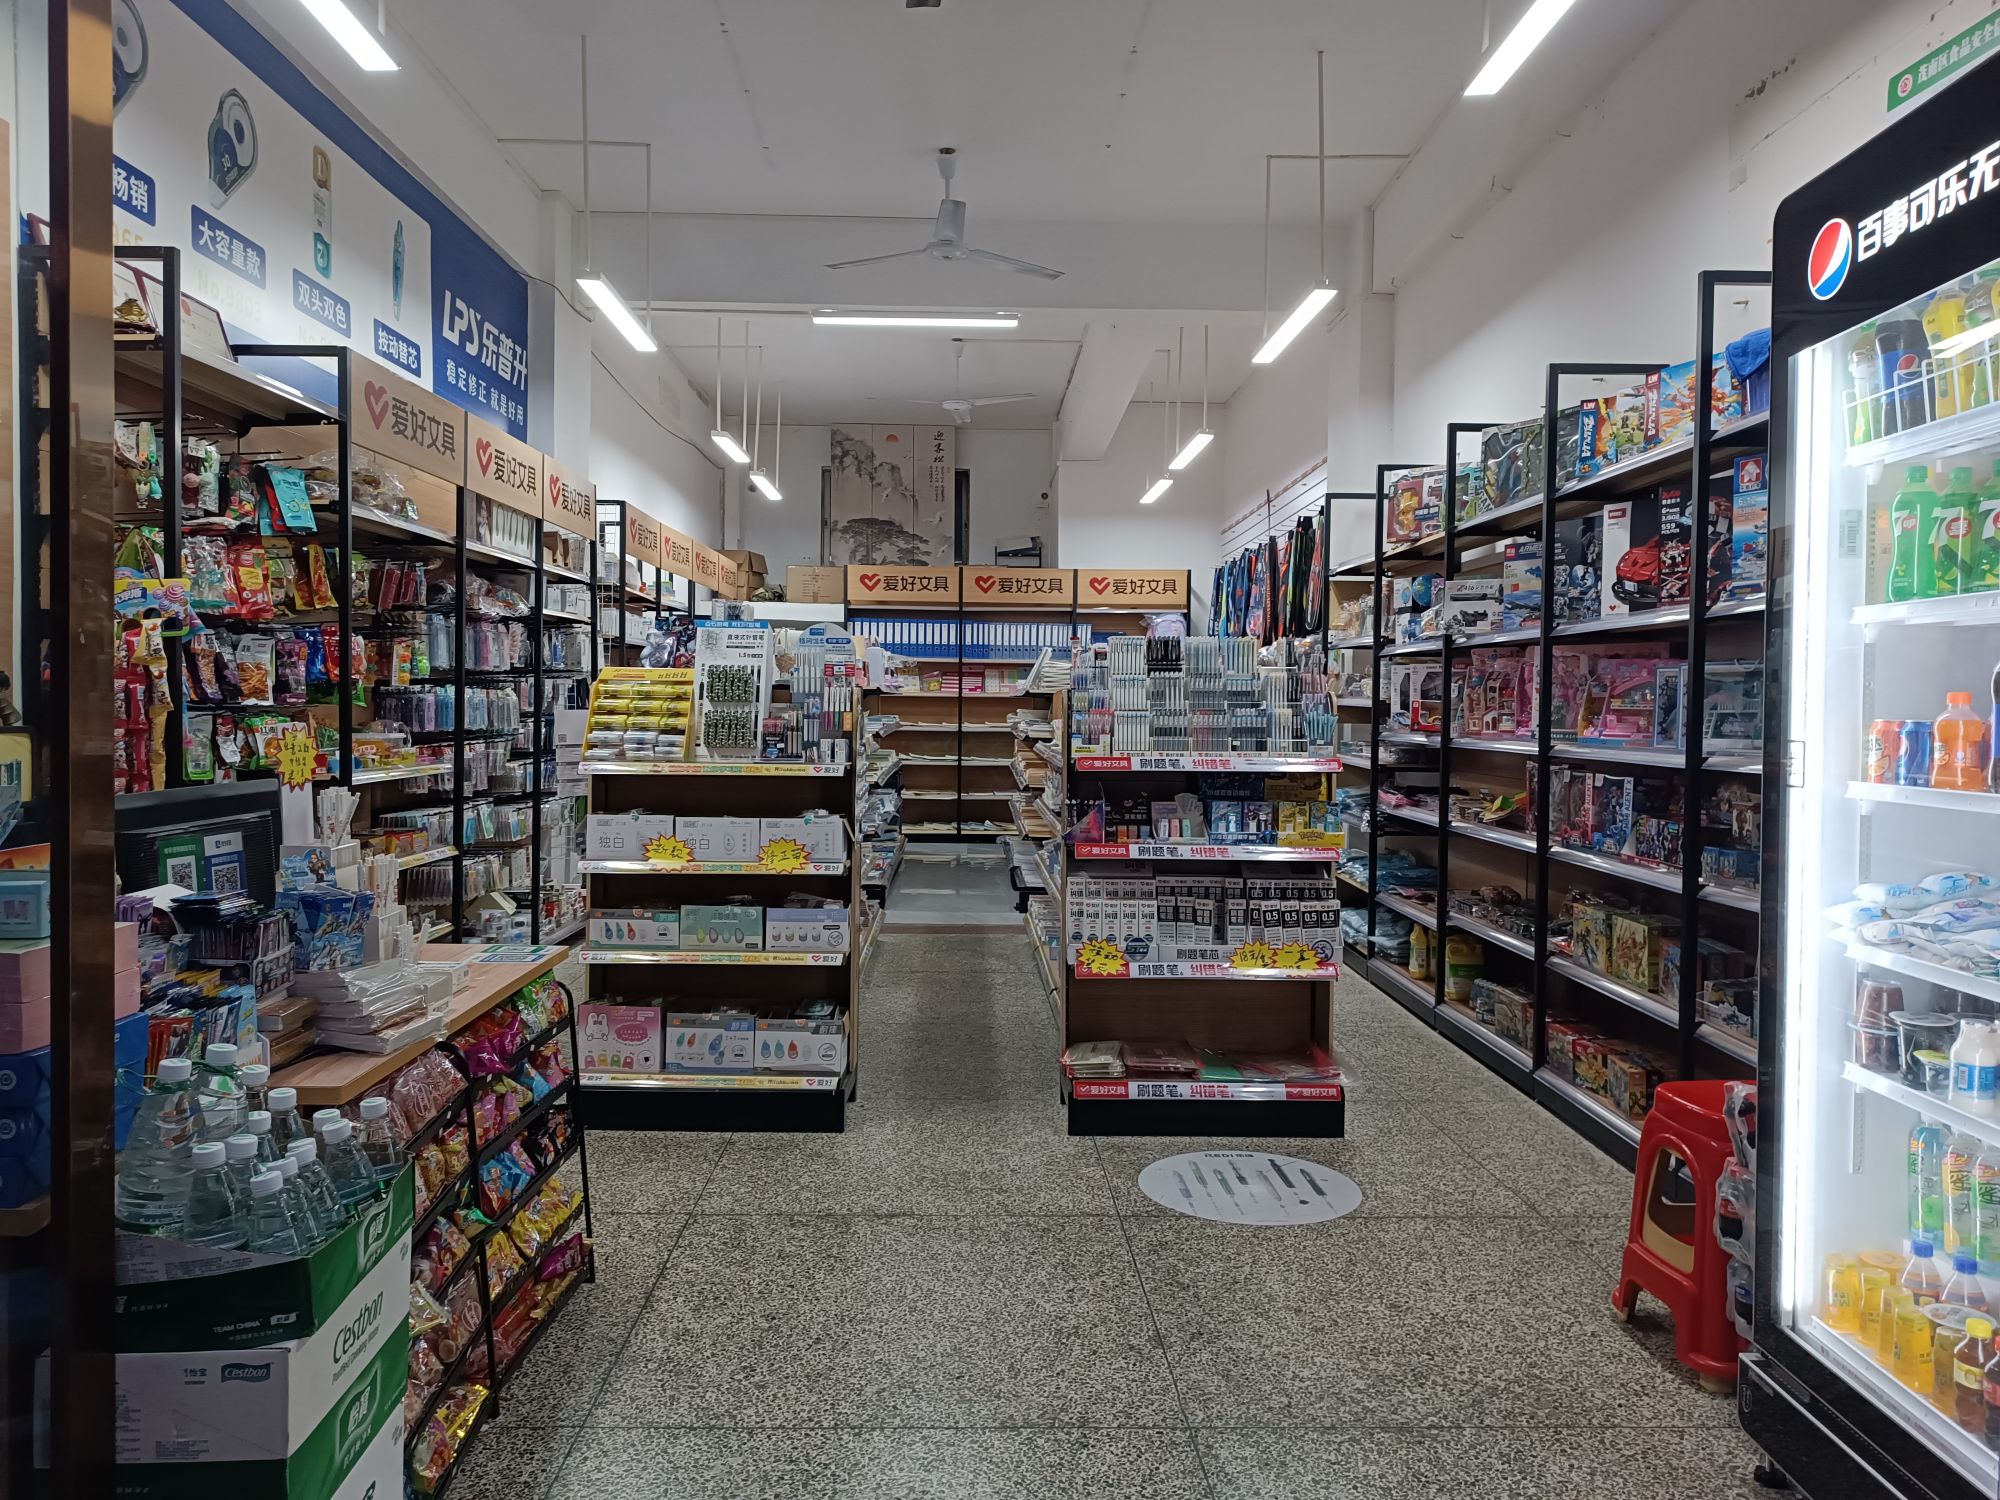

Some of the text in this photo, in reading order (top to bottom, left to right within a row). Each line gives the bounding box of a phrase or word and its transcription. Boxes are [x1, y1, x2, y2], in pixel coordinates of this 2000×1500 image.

[199, 220, 261, 279] 大容量款
[298, 280, 347, 329] 双头双色
[378, 327, 418, 369] 按动替芯
[481, 321, 528, 391] 乐普升
[446, 359, 524, 426] 稳定修正 就是好用
[391, 396, 456, 461] 爱好文具
[494, 448, 537, 497] 爱好文具
[561, 482, 591, 522] 爱好文具
[882, 575, 949, 592] 爱好文具
[998, 577, 1064, 594] 爱好文具
[1112, 578, 1177, 595] 爱好文具
[1093, 760, 1129, 768] 爱好文具
[1091, 847, 1127, 856] 爱好文具
[1322, 890, 1334, 898] 0.5
[1266, 912, 1278, 920] 0.5
[1284, 912, 1298, 921] 0.5
[1304, 912, 1317, 922] 0.5
[1322, 912, 1334, 921] 0.5
[1176, 948, 1219, 960] 刷题笔芯
[1090, 1085, 1126, 1095] 爱好文具
[1302, 1087, 1337, 1097] 爱好文具
[213, 1320, 261, 1333] TEAM CHINA
